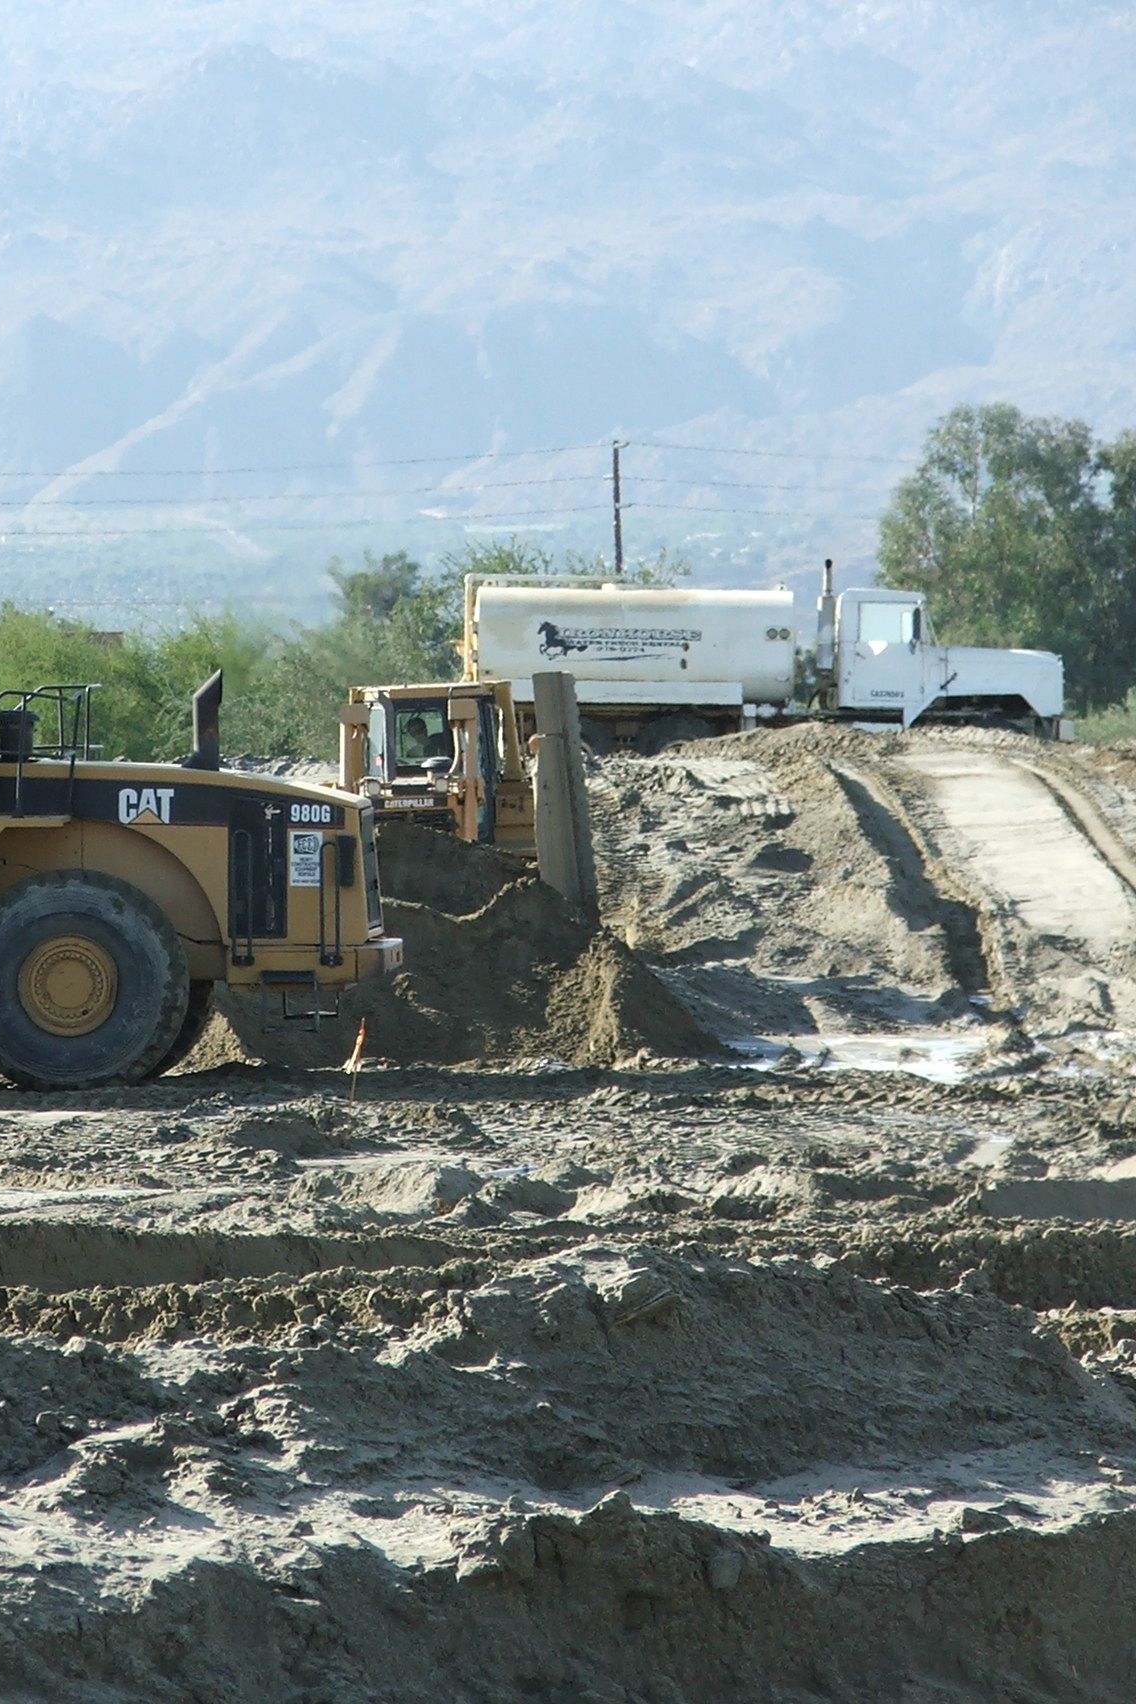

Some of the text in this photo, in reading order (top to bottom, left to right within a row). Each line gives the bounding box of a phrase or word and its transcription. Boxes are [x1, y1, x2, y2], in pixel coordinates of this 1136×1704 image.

[561, 627, 702, 642] IRONHORSE
[118, 788, 175, 824] CAT
[384, 798, 434, 809] CATERPILLAR
[290, 803, 331, 823] 980G
